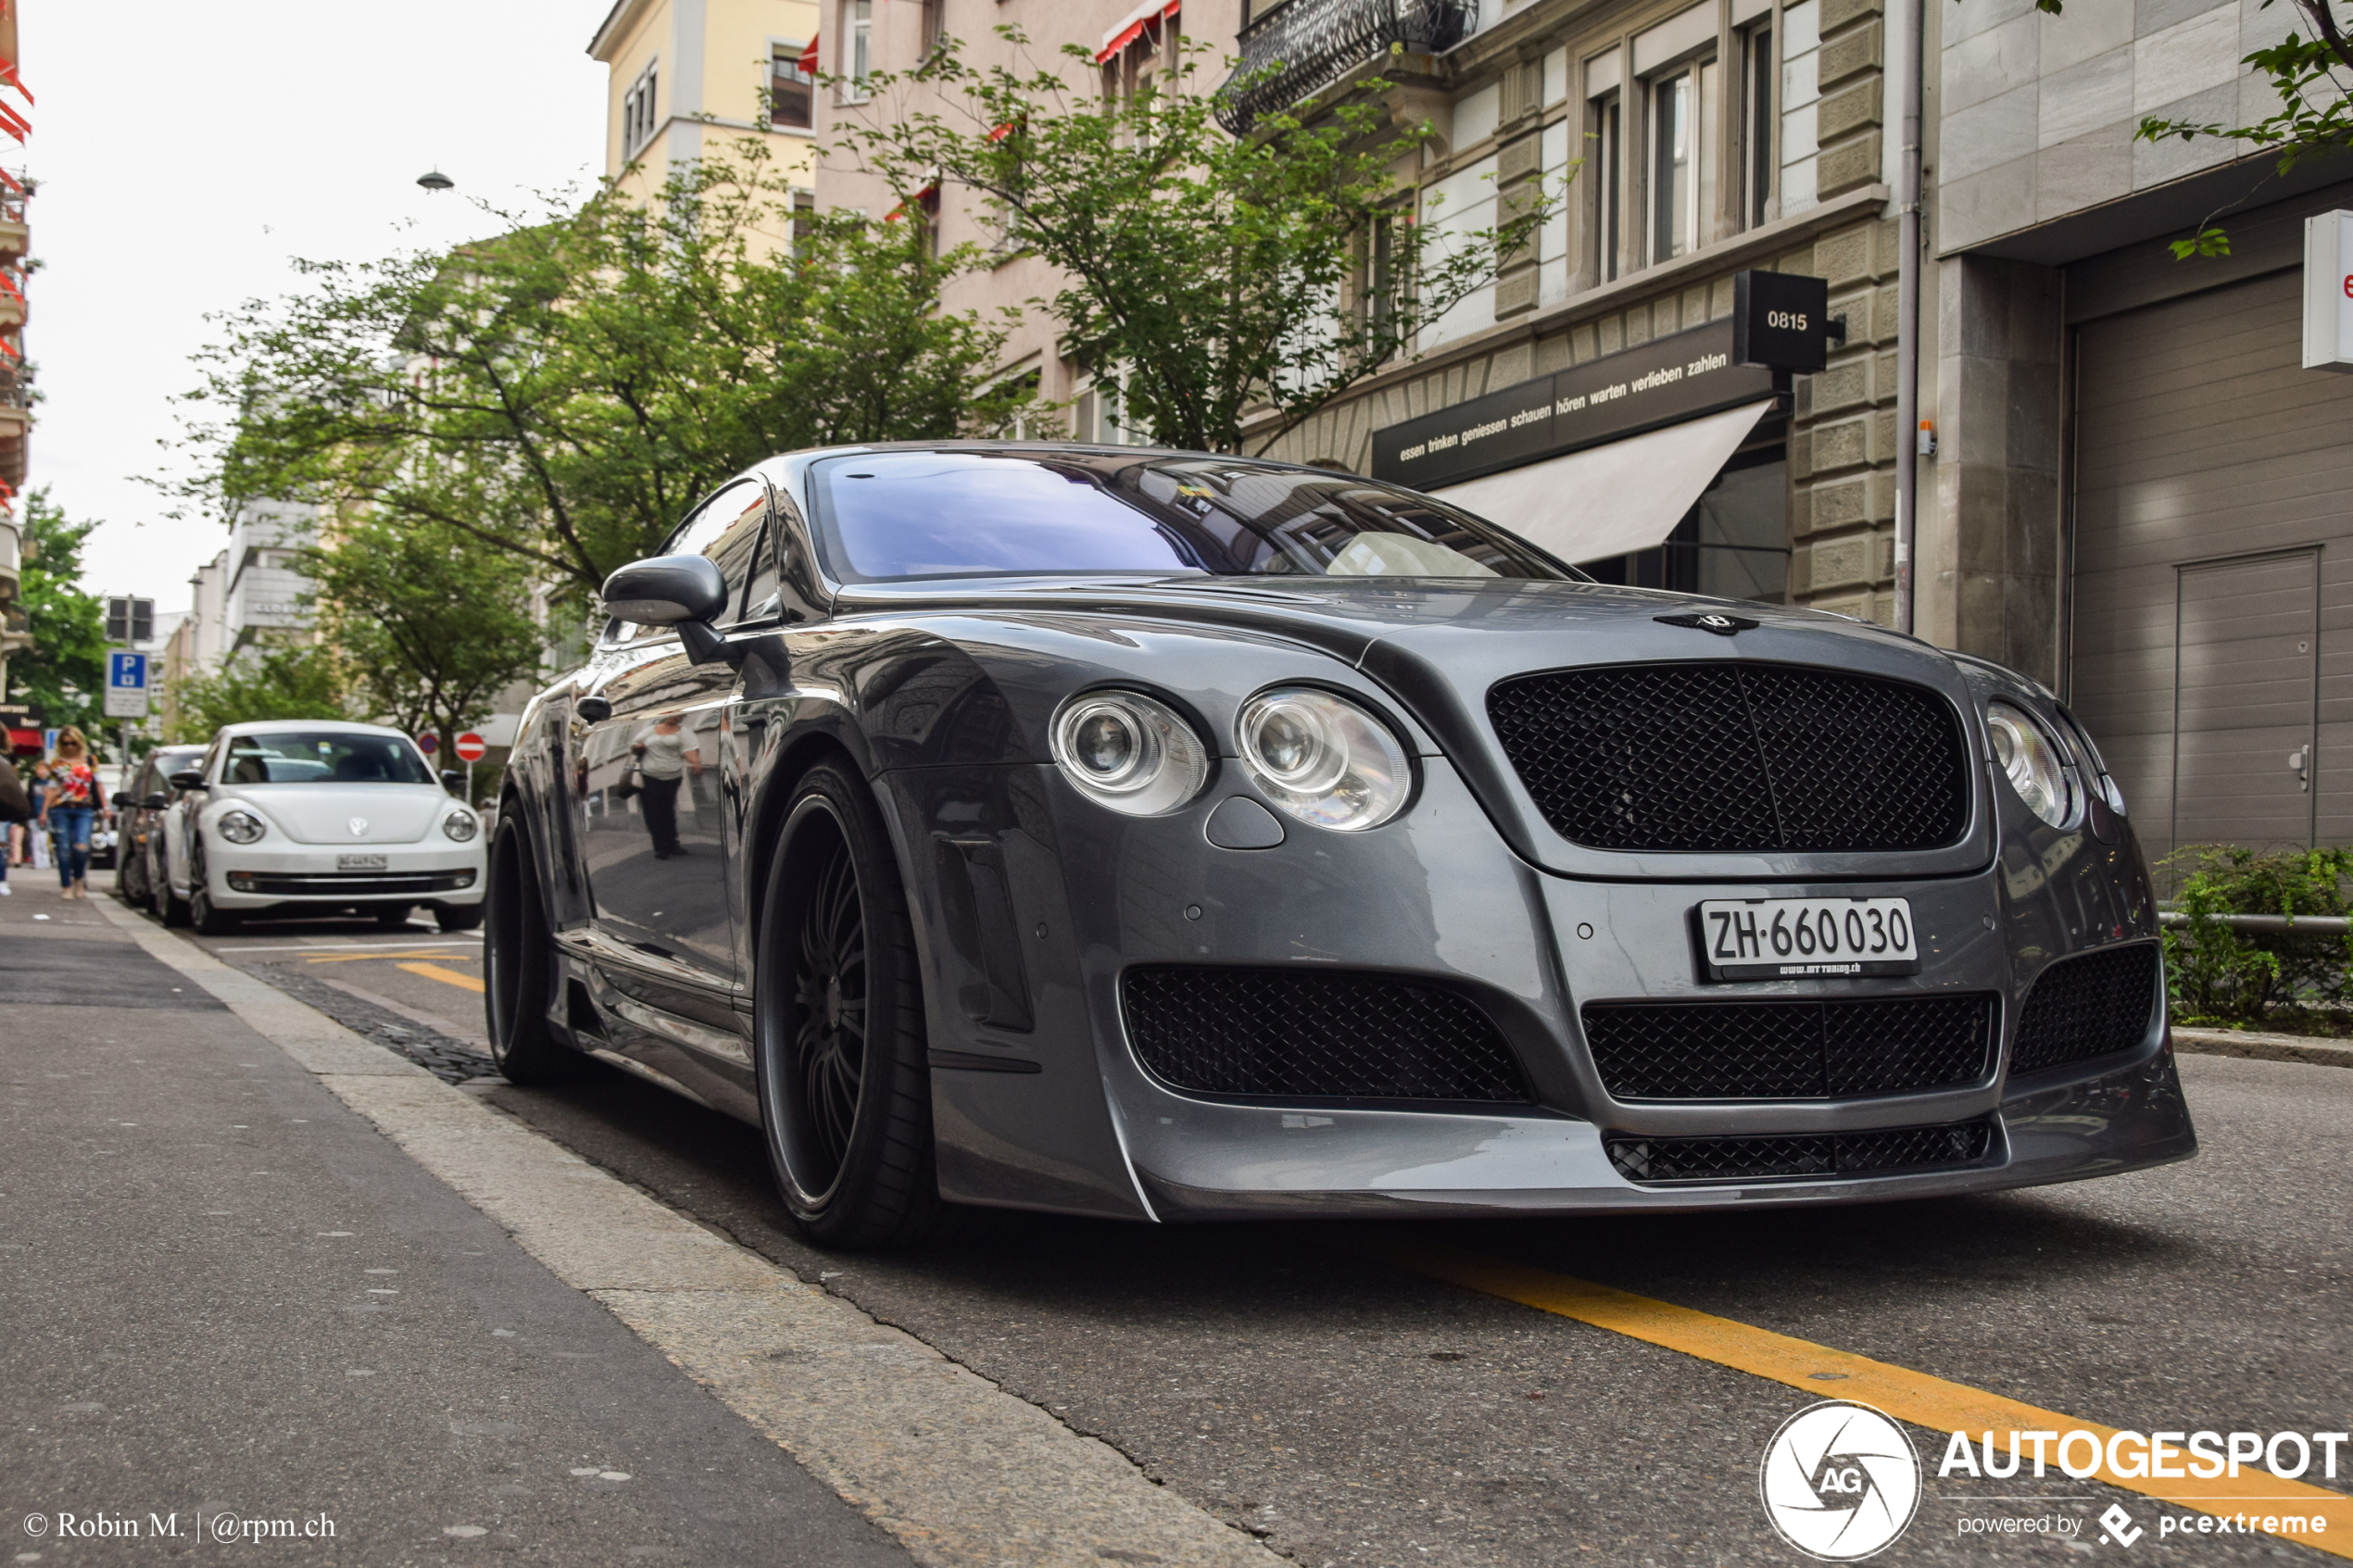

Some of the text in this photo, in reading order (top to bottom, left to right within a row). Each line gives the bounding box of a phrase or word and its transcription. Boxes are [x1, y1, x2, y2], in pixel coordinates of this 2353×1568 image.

[1768, 310, 1807, 332] 0815
[1400, 351, 1727, 461] essen trinken geniessen schauen hören warten verlieben zahlen
[122, 656, 136, 672] P
[1845, 907, 1909, 954] 030
